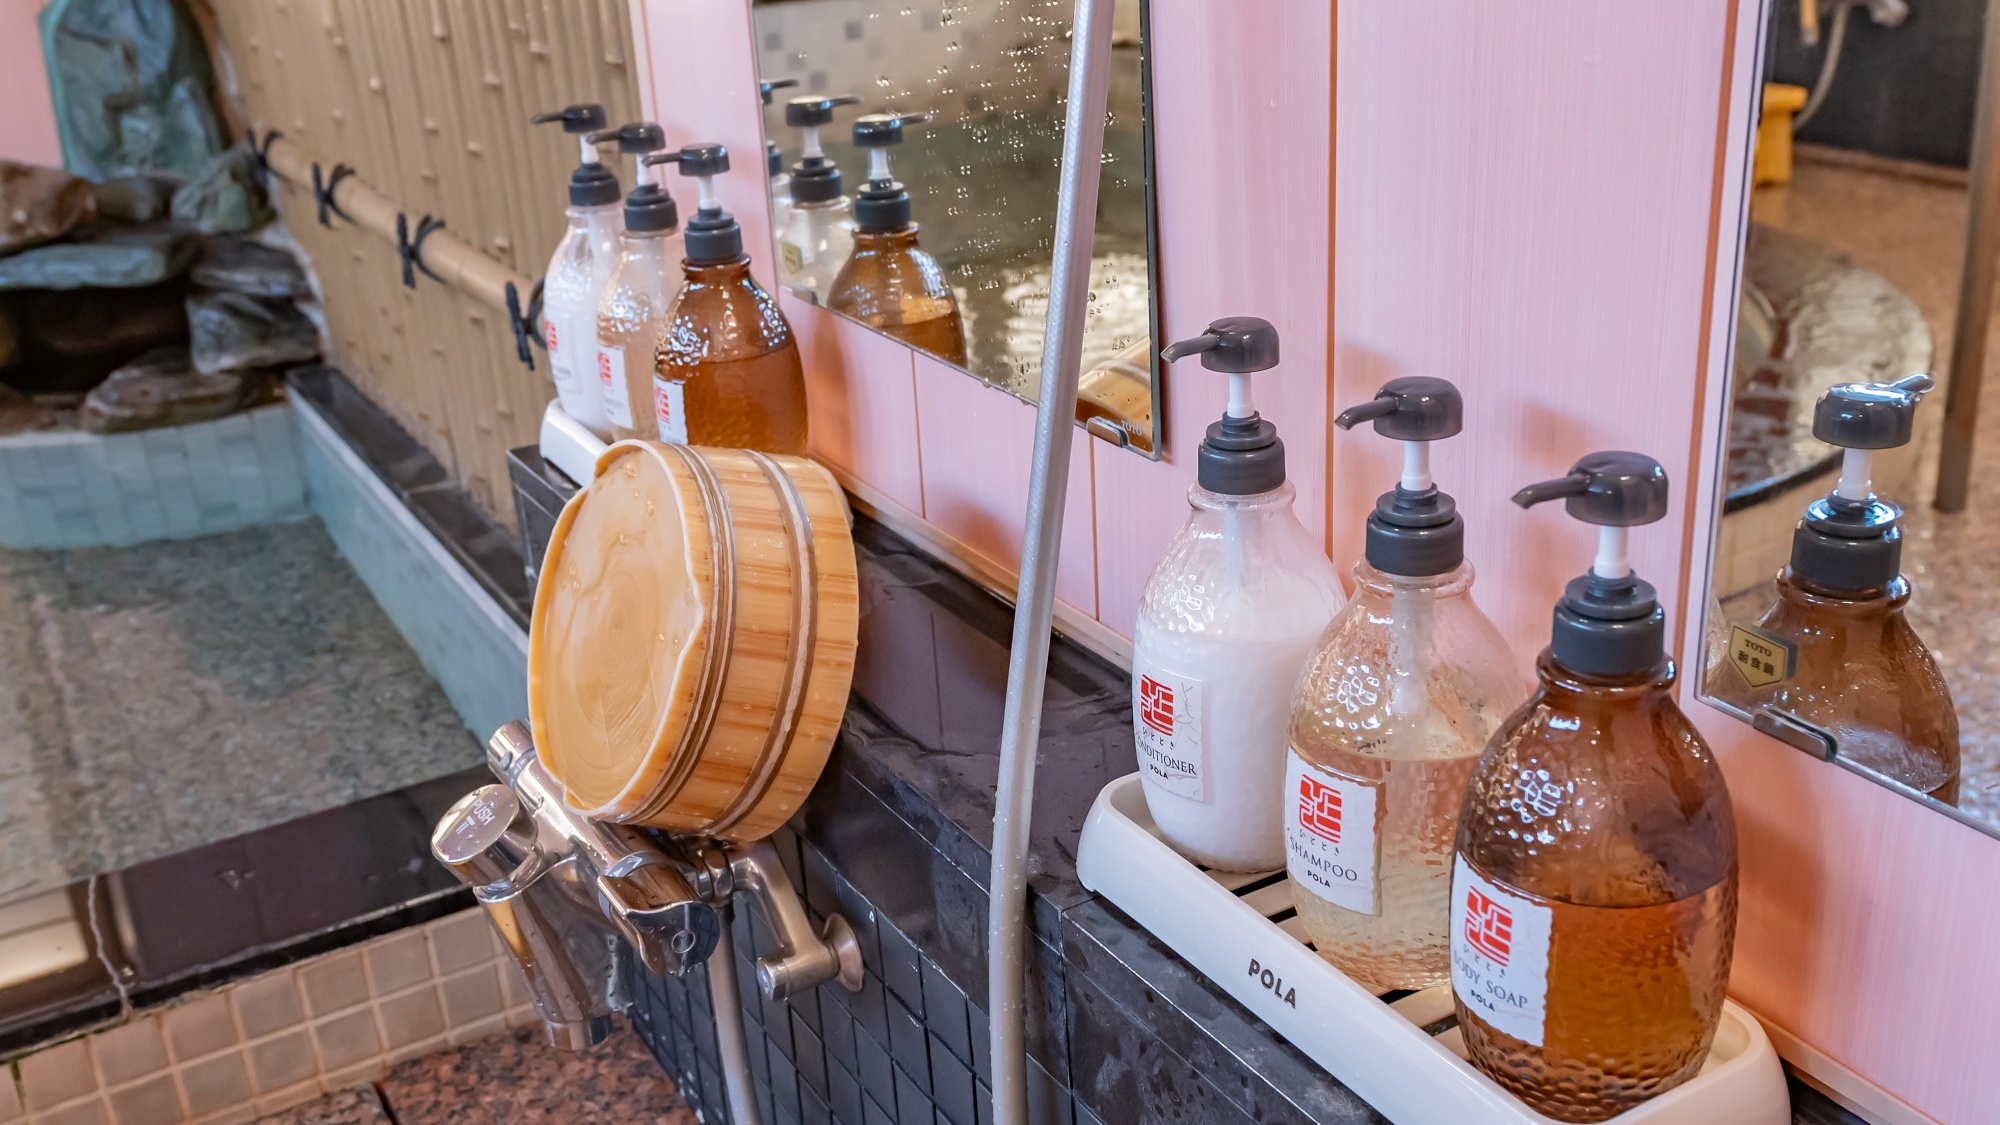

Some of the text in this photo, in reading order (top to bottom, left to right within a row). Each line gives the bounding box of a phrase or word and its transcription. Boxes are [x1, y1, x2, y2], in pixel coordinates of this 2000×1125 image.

[1744, 639, 1772, 657] TOTO
[1149, 763, 1169, 779] POLA
[470, 798, 496, 825] PUSH
[1290, 836, 1358, 881] SHAMPOO
[1307, 869, 1331, 888] POLA
[1248, 958, 1296, 1010] POLA
[1485, 980, 1528, 1009] SOAP
[1470, 989, 1496, 1012] POLA
